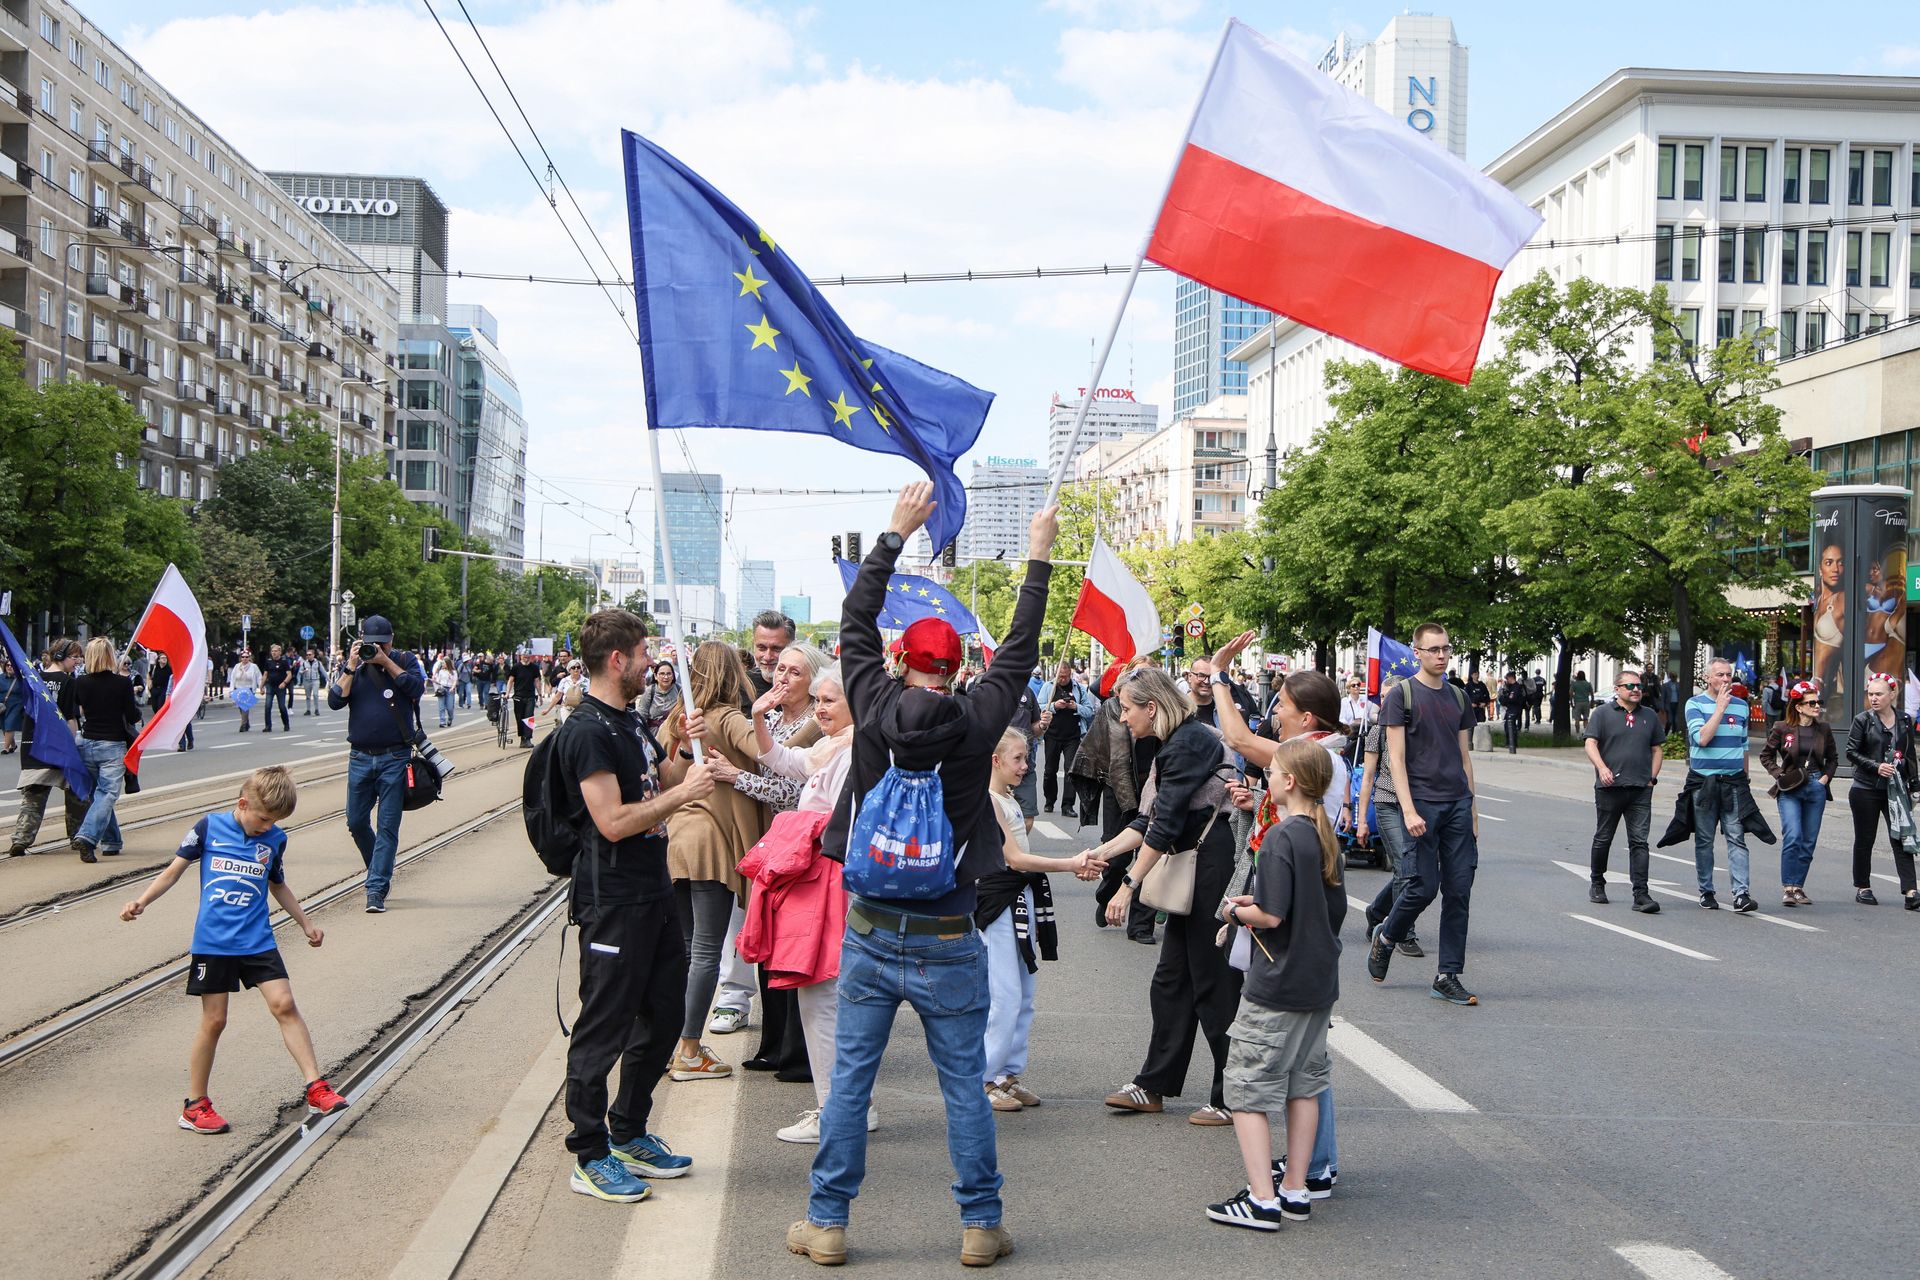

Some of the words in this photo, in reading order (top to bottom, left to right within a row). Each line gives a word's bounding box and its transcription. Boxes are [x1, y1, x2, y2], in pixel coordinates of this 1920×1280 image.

[987, 456, 1038, 466] Hisense
[870, 831, 942, 859] IRONMAN
[868, 844, 897, 867] 70.3
[224, 860, 265, 876] Dantex
[209, 887, 254, 907] PGE
